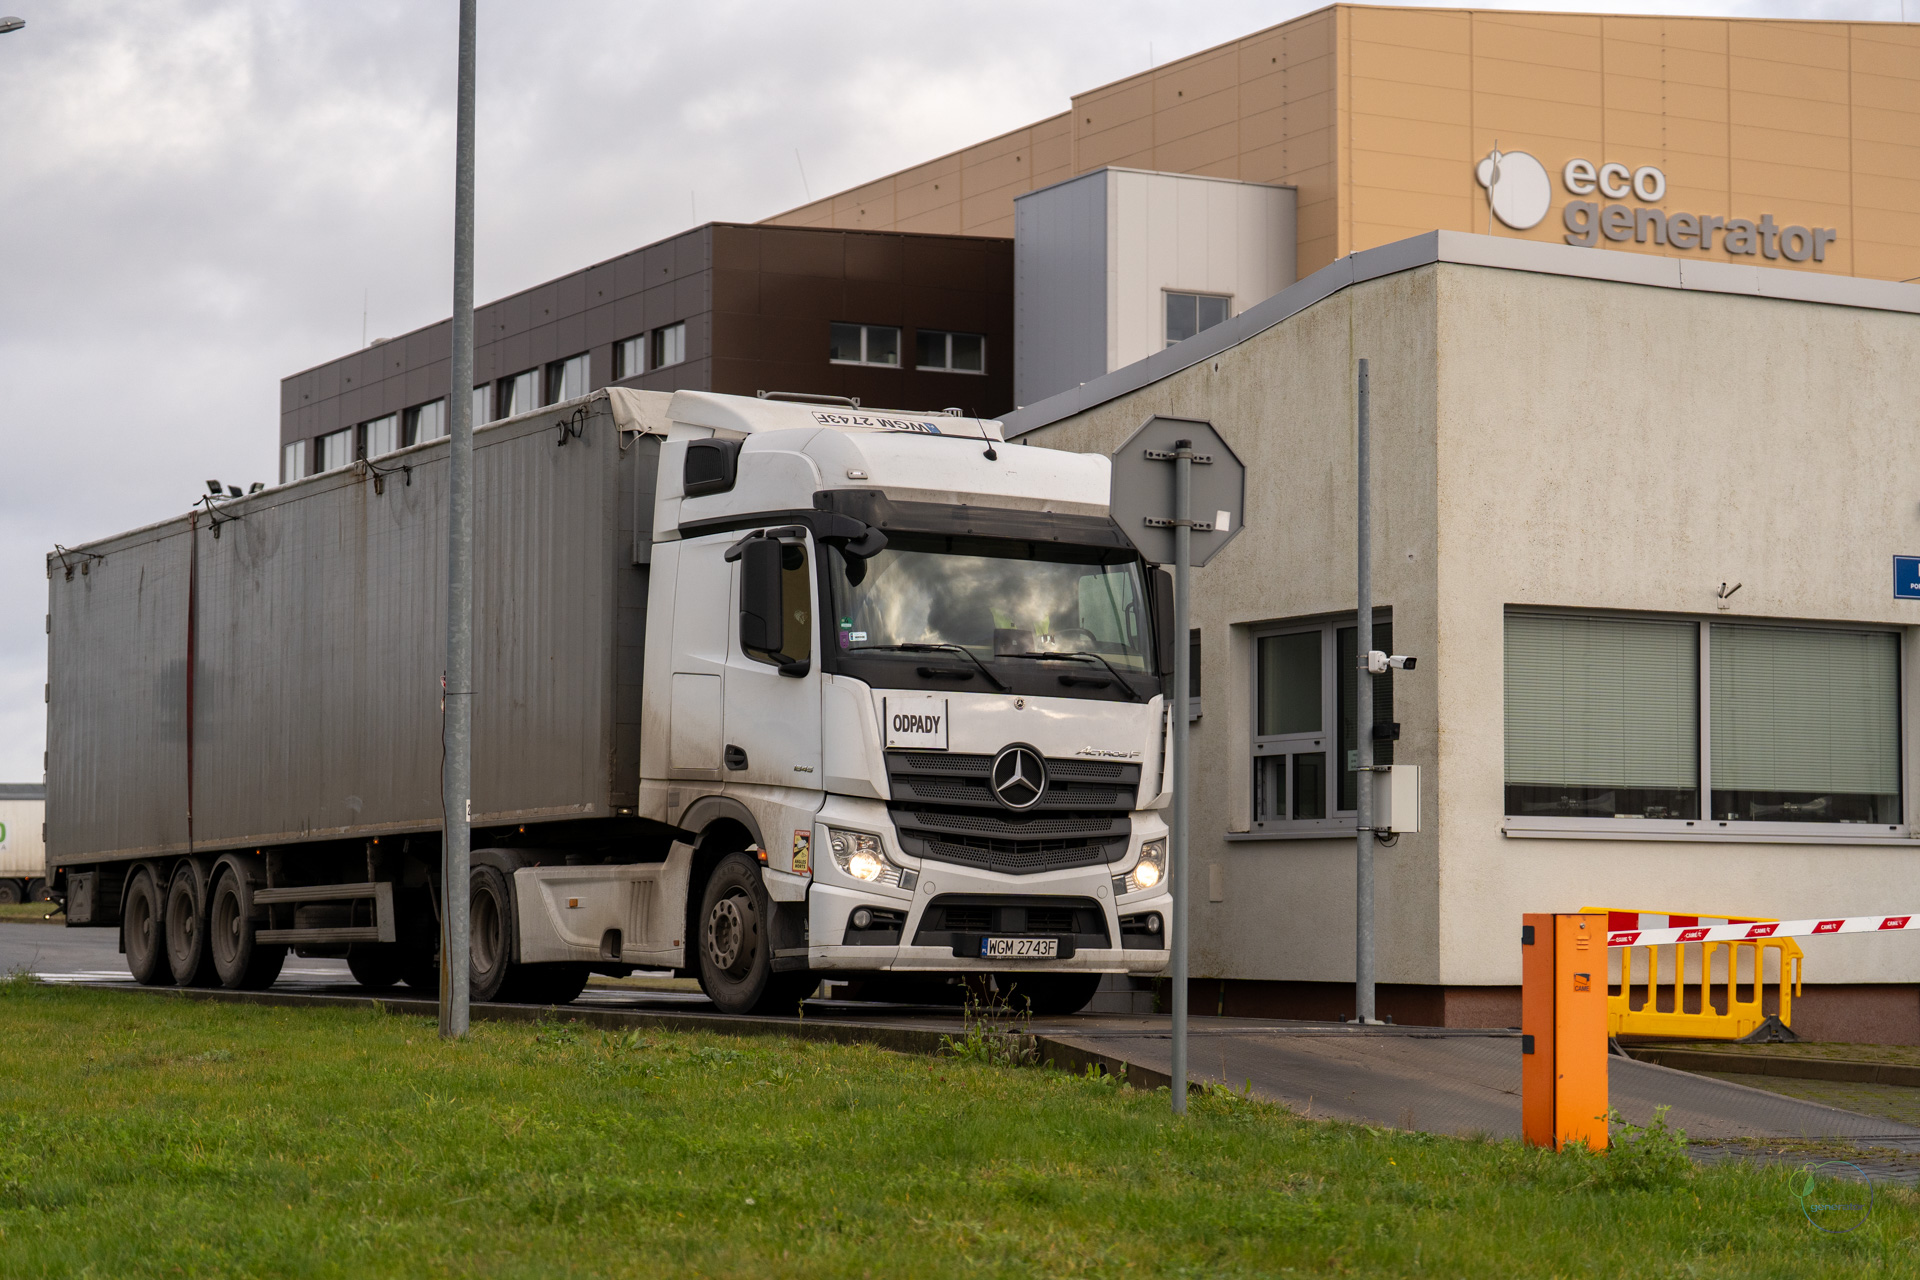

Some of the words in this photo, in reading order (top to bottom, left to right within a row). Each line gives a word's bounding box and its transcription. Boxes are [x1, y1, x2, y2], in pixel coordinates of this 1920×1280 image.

[1563, 158, 1666, 202] eco
[1563, 199, 1836, 262] generator
[818, 413, 874, 426] 2743F
[876, 418, 930, 432] WGM
[893, 714, 941, 734] ODPADY
[989, 939, 1014, 955] WGM
[1017, 940, 1056, 955] 2743F
